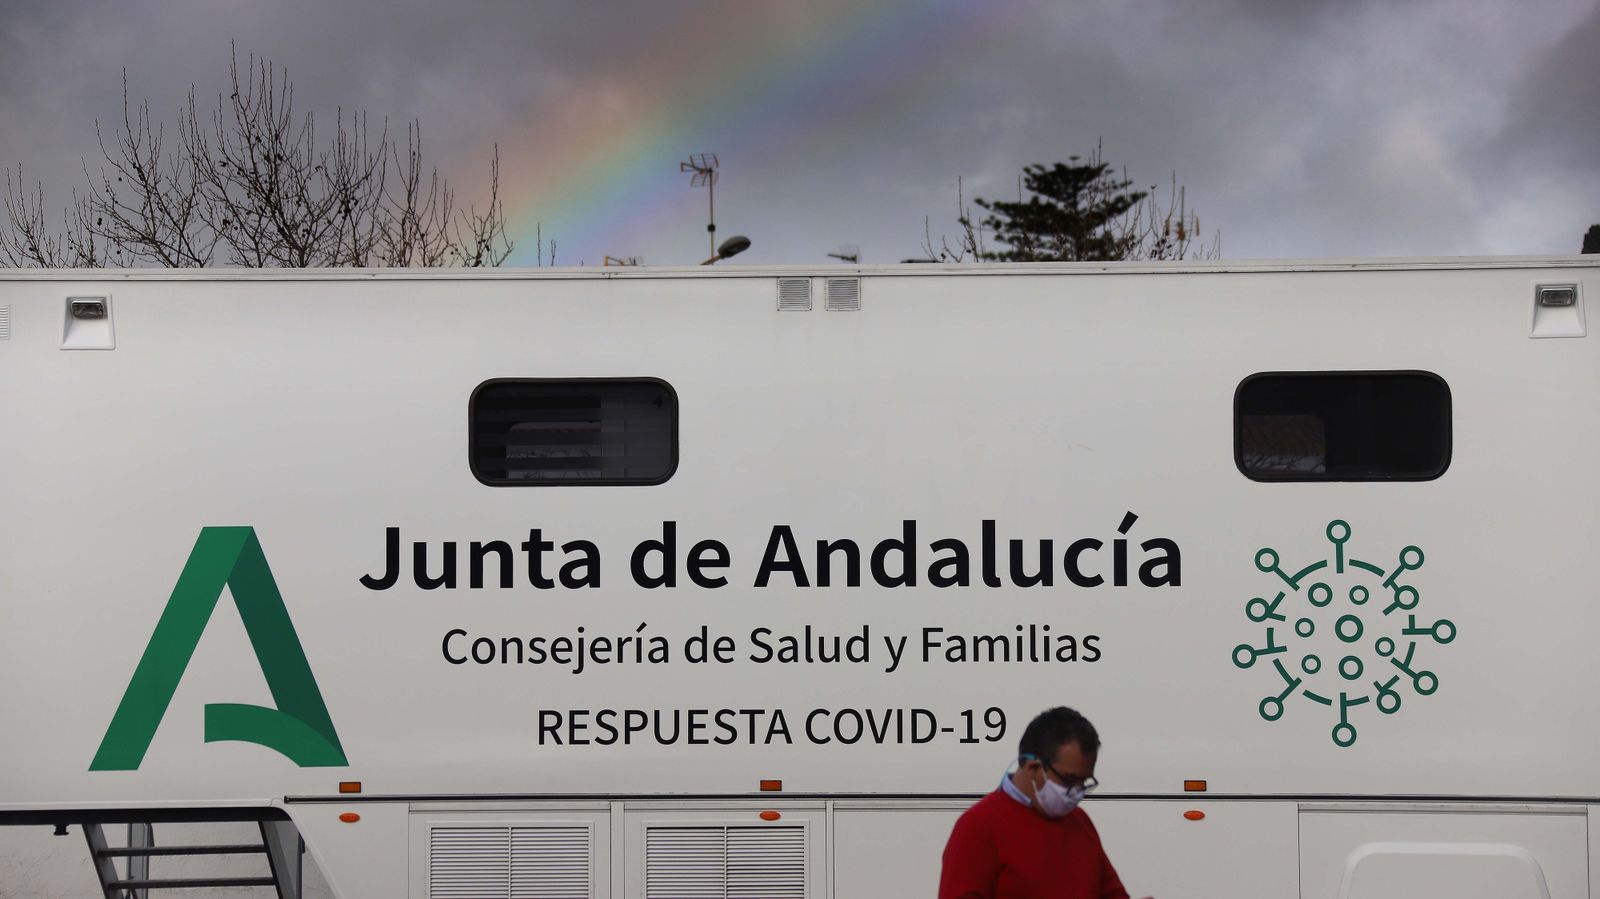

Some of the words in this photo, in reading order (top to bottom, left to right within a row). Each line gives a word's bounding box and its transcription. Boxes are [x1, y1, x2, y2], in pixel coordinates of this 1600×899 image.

[359, 526, 601, 591] Junta
[630, 520, 731, 590] de
[753, 510, 1182, 589] Andalucía
[441, 621, 669, 675] Consejería
[684, 625, 736, 664] de
[749, 624, 870, 664] Salud
[883, 635, 908, 674] y
[922, 623, 1102, 663] Familias
[538, 708, 793, 746] RESPUESTA
[805, 706, 1007, 745] COVID-19
